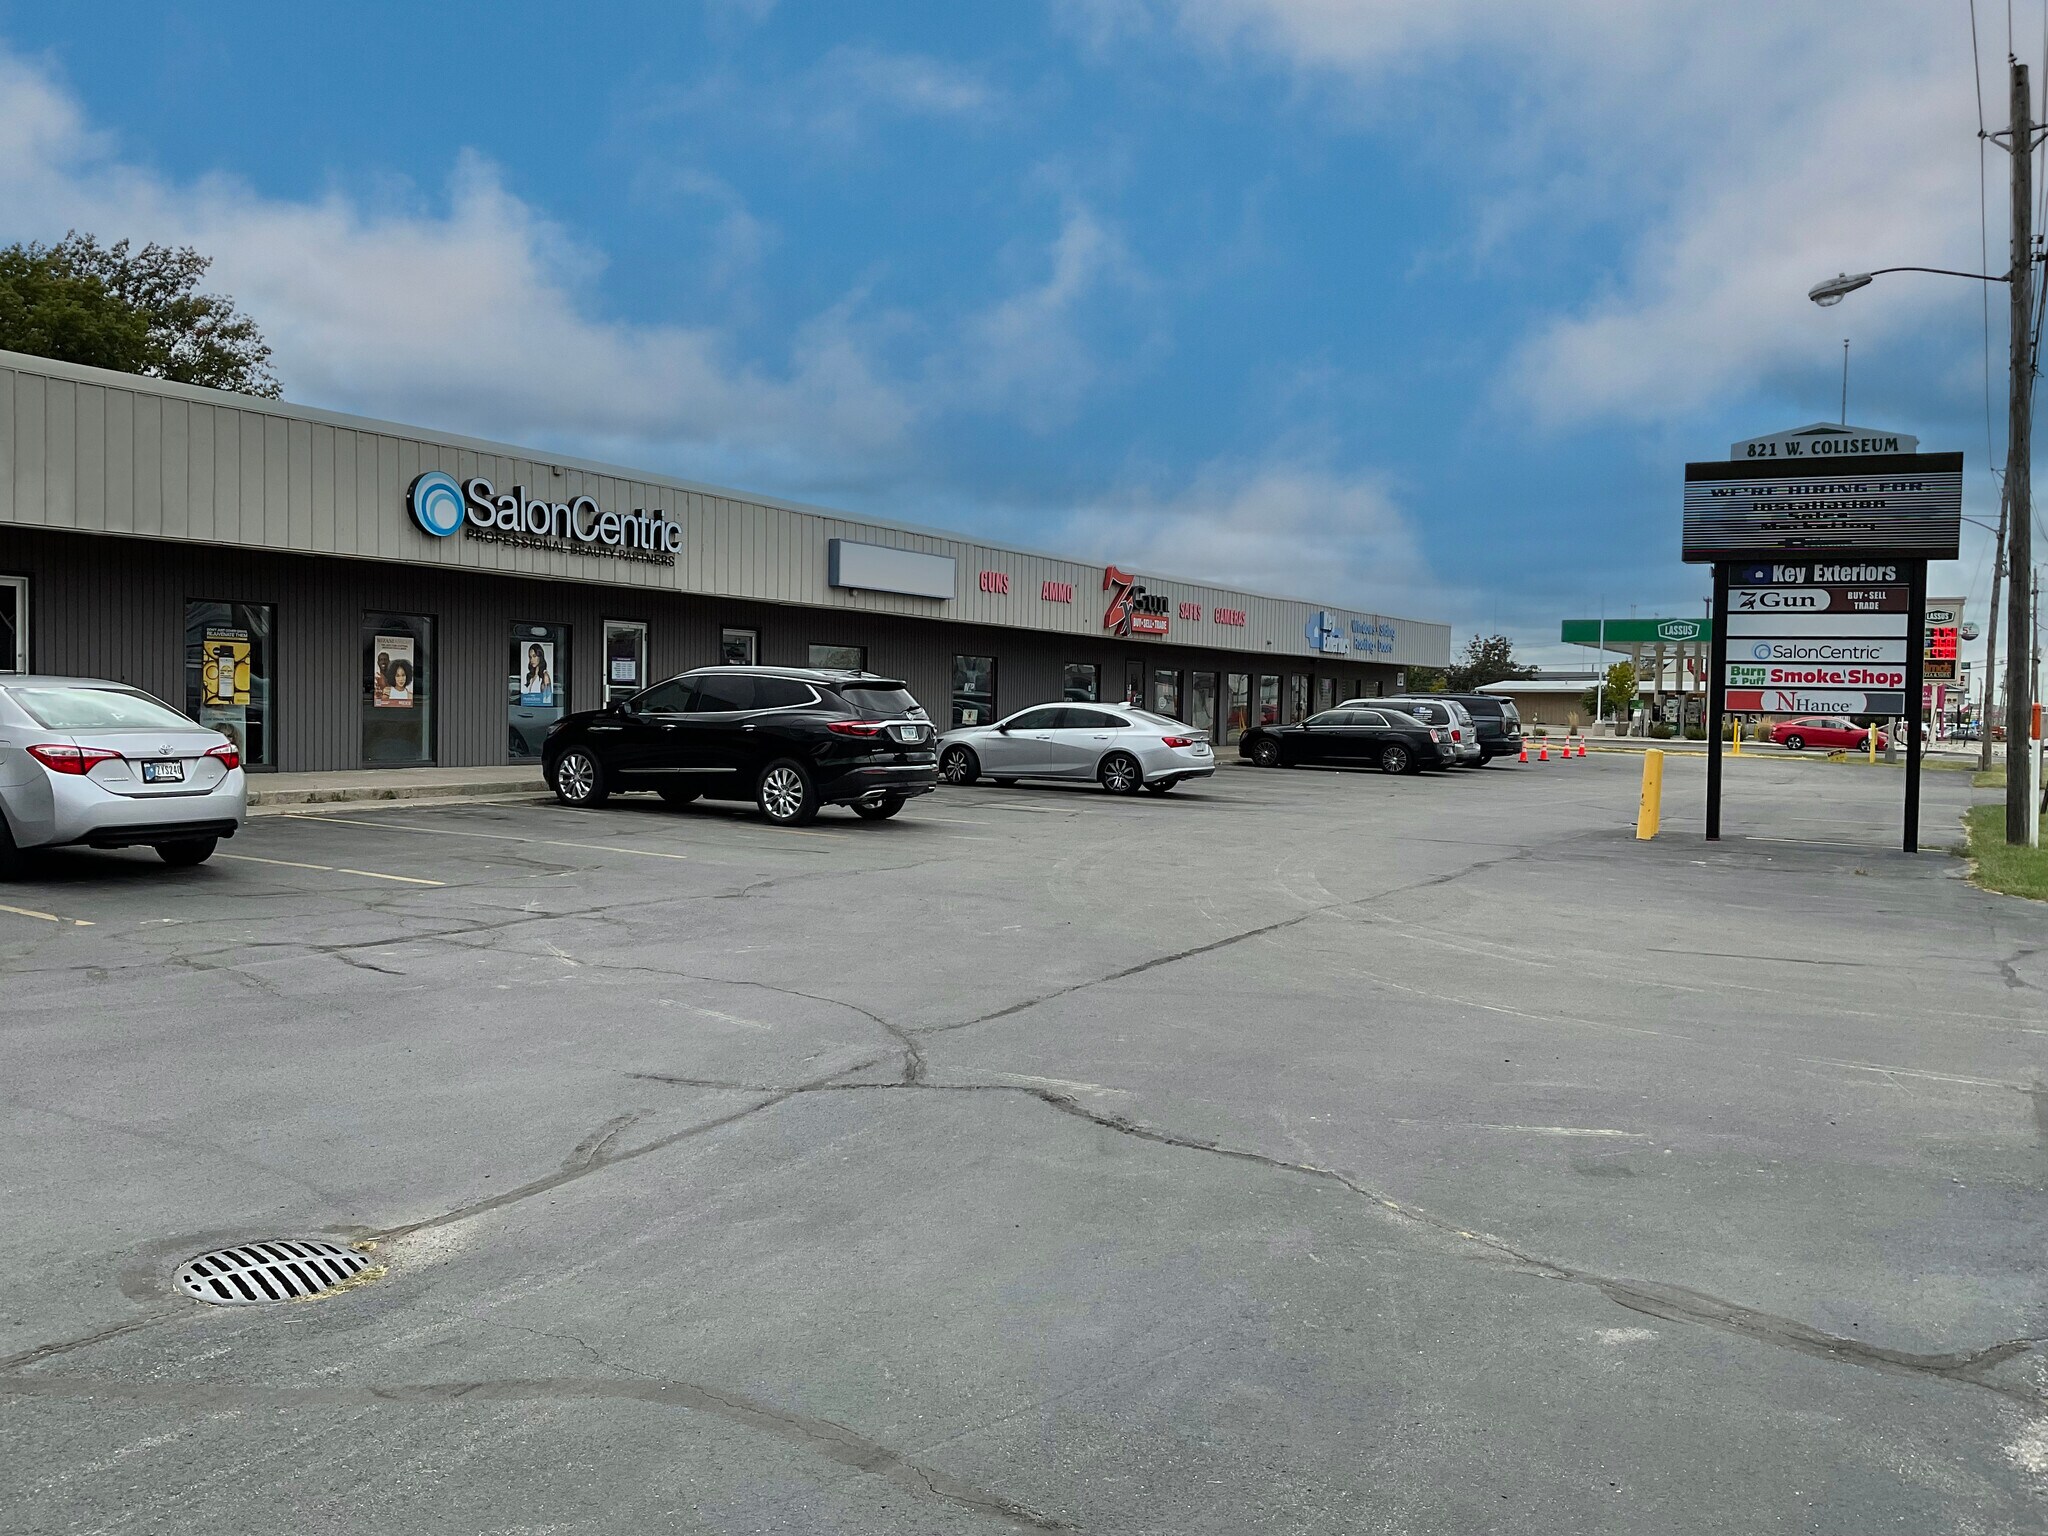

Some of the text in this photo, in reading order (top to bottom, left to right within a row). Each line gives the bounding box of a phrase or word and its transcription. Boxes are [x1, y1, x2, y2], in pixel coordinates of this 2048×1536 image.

[1747, 438, 1899, 457] 821 W. COLISEUM
[462, 477, 683, 556] SalonCentric
[466, 528, 675, 567] PROFESSIONAL BEAUTY PARTNERS
[1772, 563, 1897, 584] Key Exteriors
[979, 571, 1009, 595] GUNS
[1041, 581, 1074, 604] AMMO
[1847, 591, 1887, 600] BUY SELL
[1178, 602, 1202, 621] SAFES
[1854, 601, 1880, 610] TRADE
[1214, 607, 1247, 627] CAMERAS
[1926, 612, 1950, 621] LASSUS
[1664, 625, 1693, 636] LASSUS
[1772, 644, 1880, 660] SalonCentric
[1730, 665, 1766, 677] Burn
[1770, 669, 1903, 687] Smoke Shop
[1729, 677, 1766, 685] & Puff
